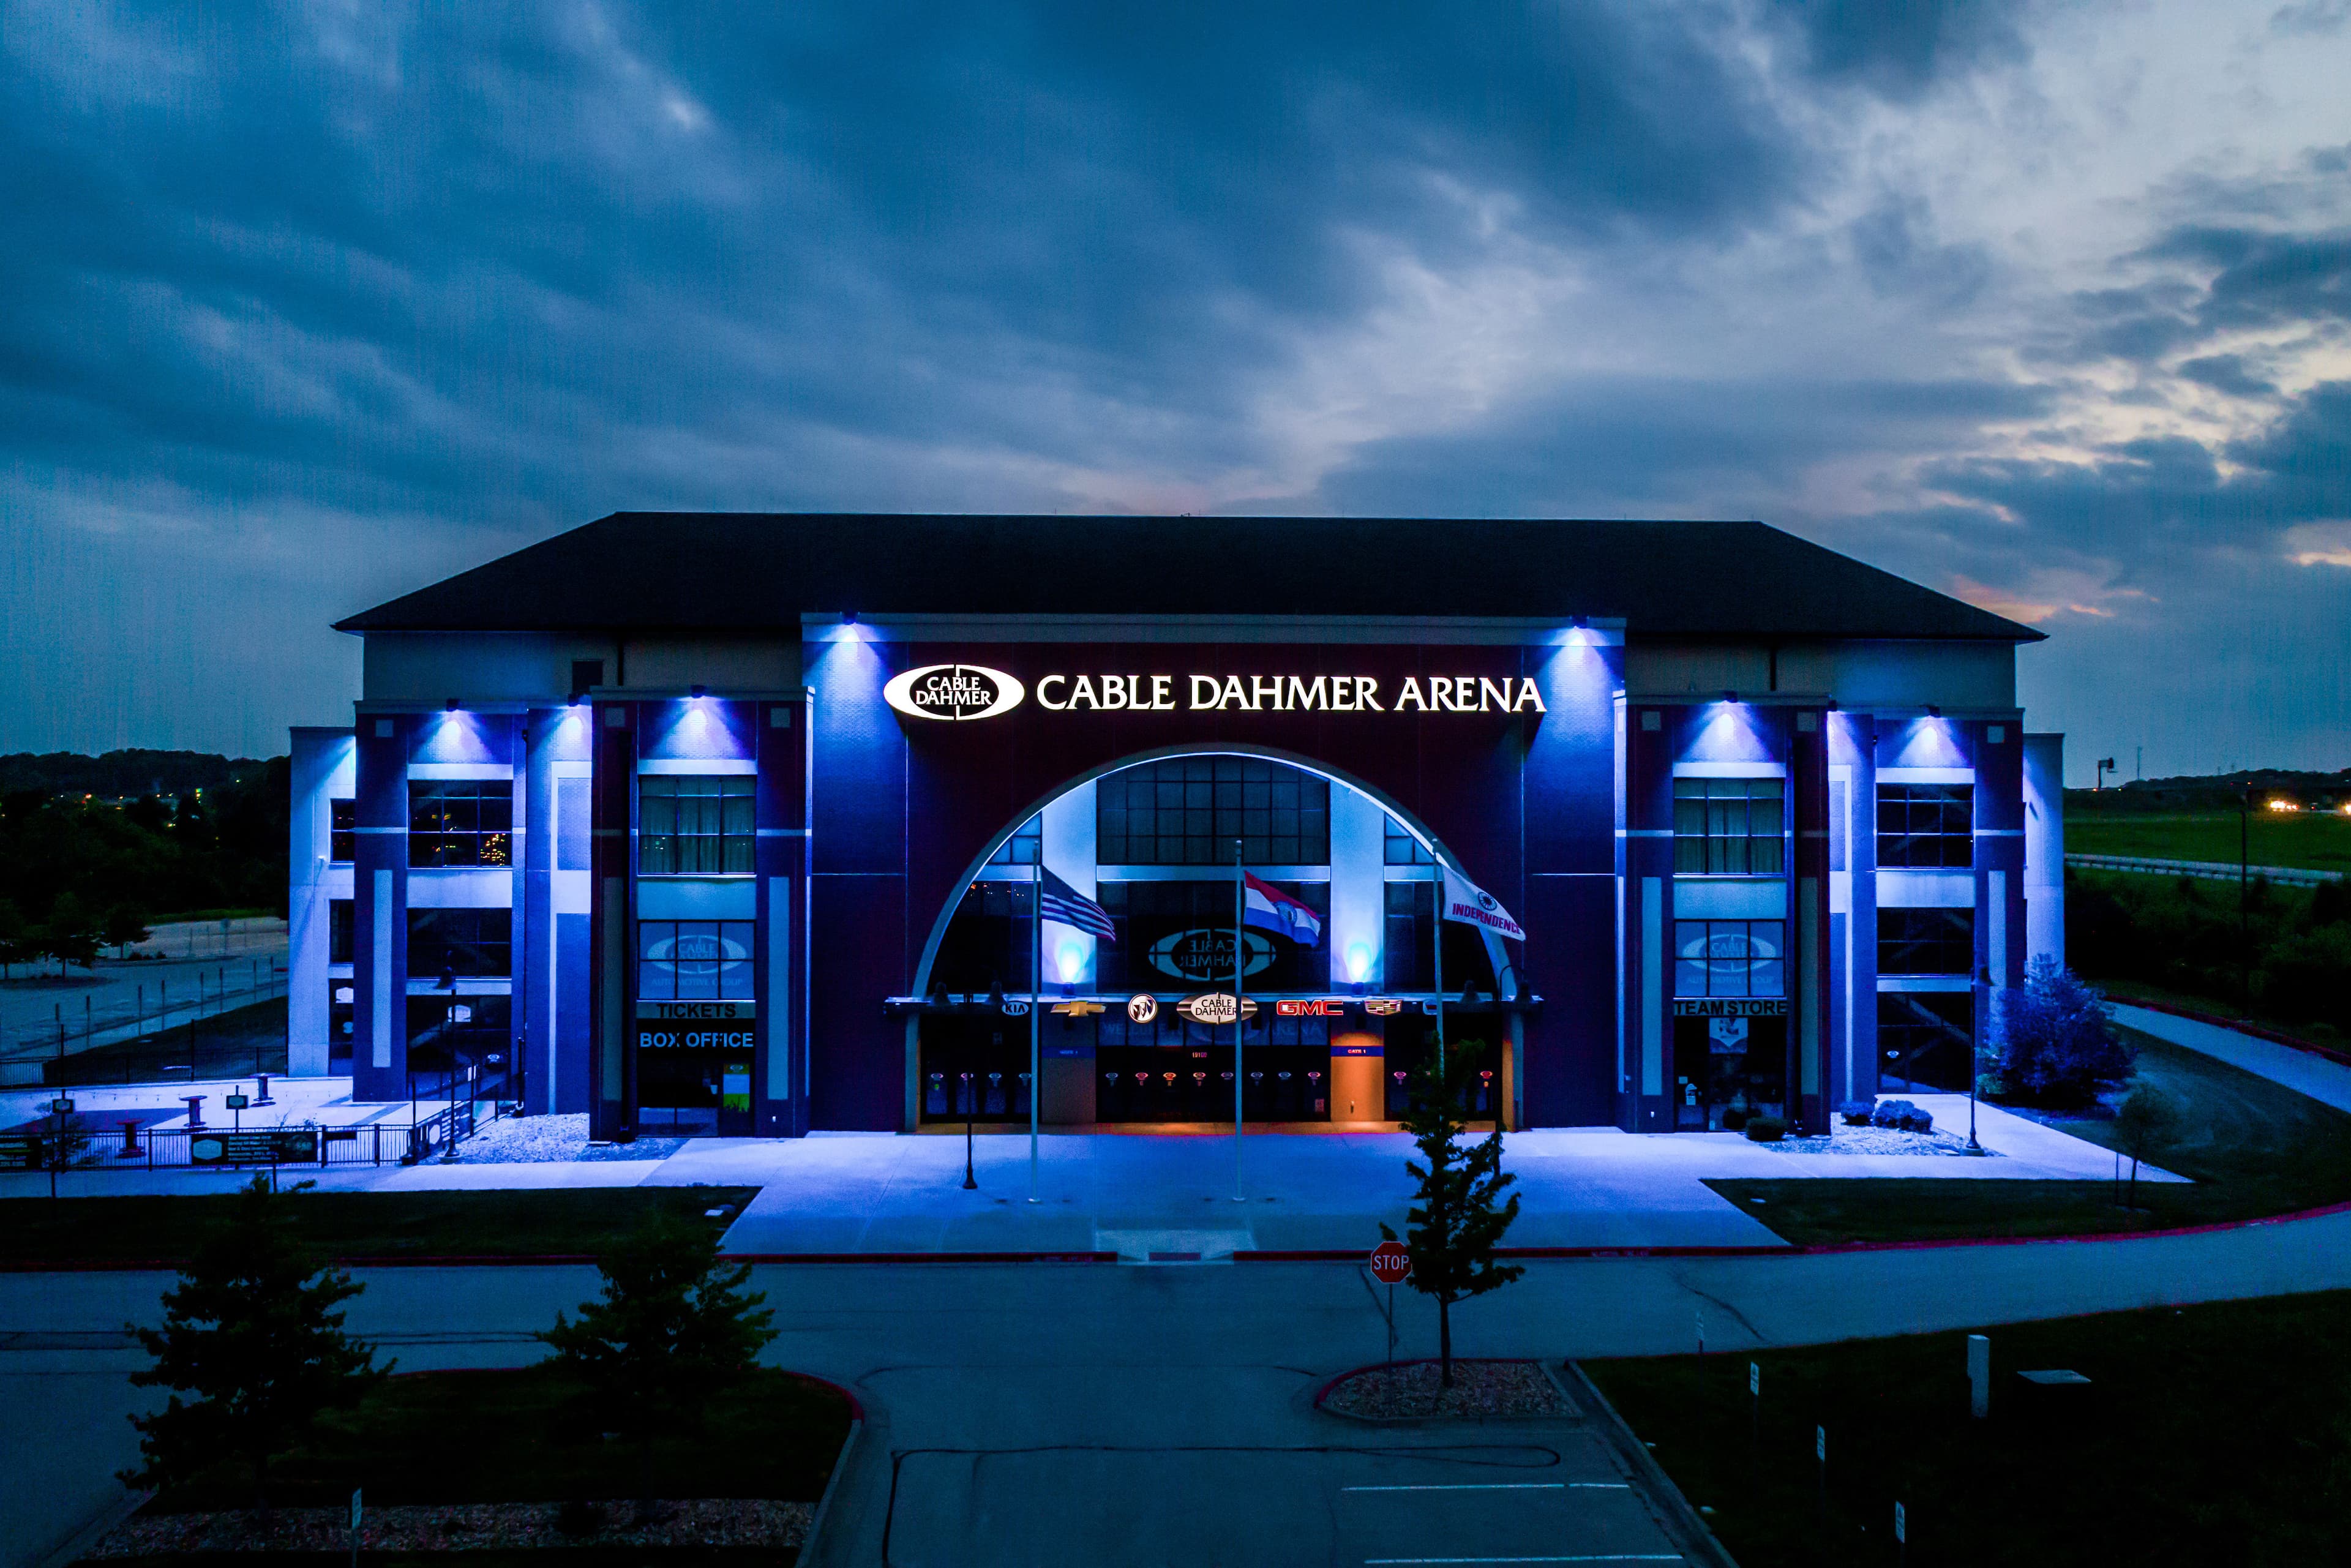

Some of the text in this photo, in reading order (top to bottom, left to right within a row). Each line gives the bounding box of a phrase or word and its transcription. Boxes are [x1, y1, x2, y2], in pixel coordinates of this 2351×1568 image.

[926, 677, 981, 691] CABLE
[916, 691, 992, 705] DAHMER
[1037, 675, 1547, 712] CABLE DAHMER ARENA
[1452, 903, 1520, 934] INDEPENDENCE
[657, 1003, 736, 1018] TICKETS
[1005, 1004, 1026, 1013] KIA
[1277, 999, 1344, 1016] GMC
[1674, 1001, 1788, 1015] TEAM STORE
[640, 1032, 754, 1048] BOX OFFICE
[1374, 1255, 1409, 1270] STOP
